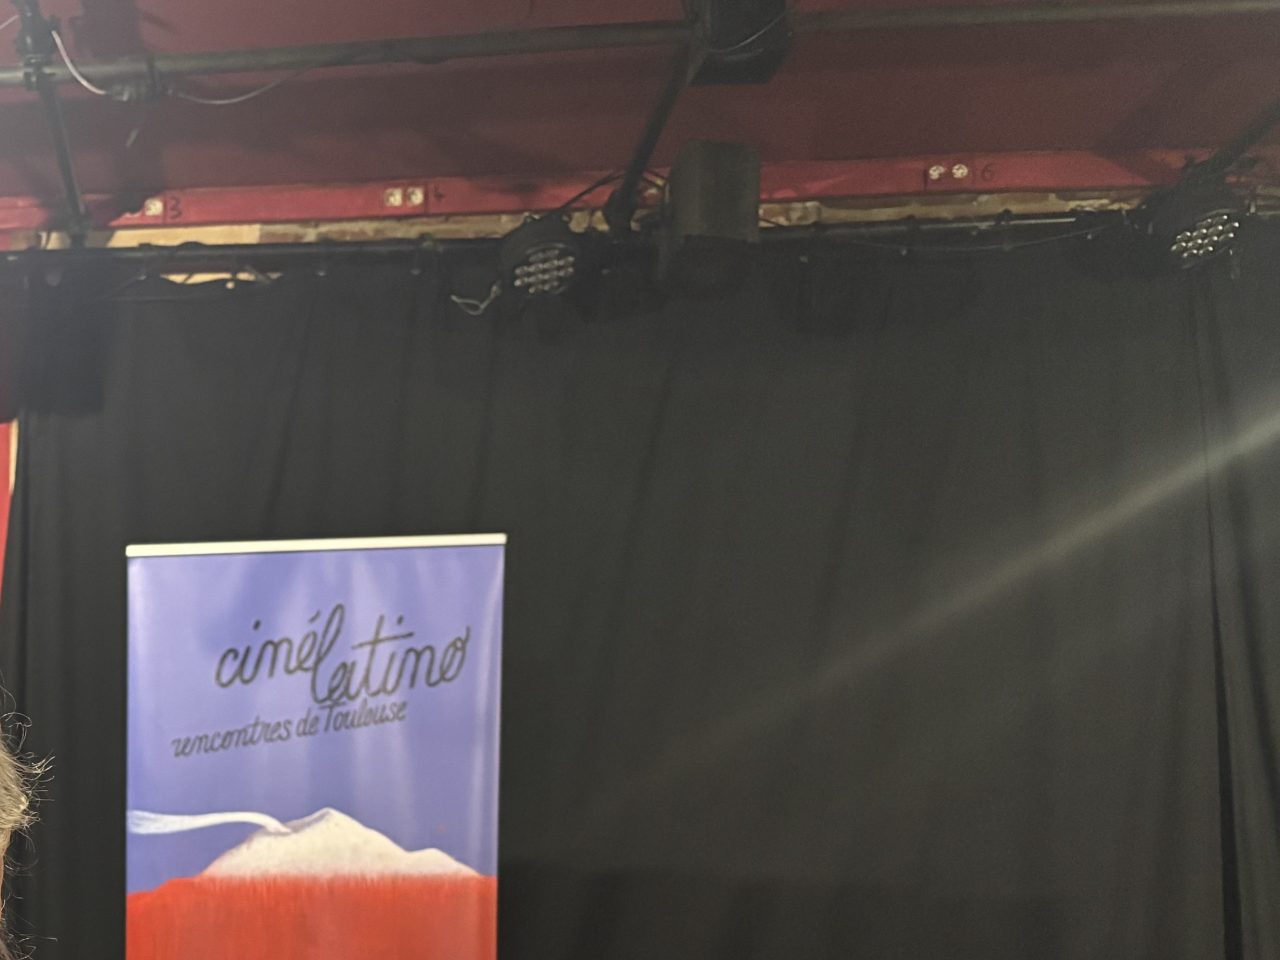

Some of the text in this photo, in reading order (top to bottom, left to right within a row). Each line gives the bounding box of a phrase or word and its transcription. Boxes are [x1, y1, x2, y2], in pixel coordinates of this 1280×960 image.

[171, 700, 407, 757] rencontres de Toulouse
